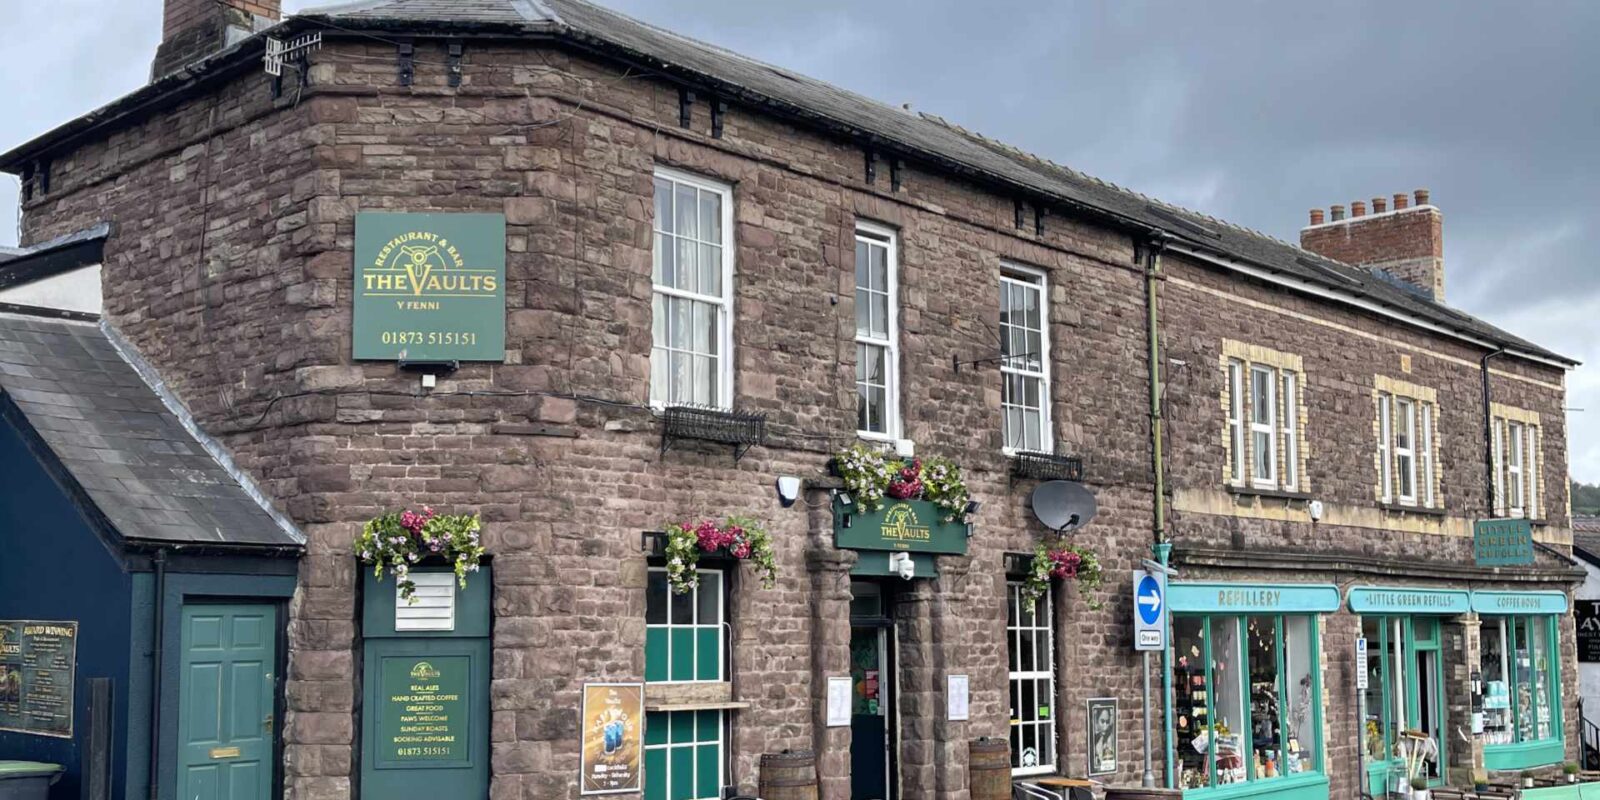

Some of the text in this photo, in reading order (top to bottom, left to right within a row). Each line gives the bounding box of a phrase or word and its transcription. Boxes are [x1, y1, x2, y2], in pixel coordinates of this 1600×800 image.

[375, 232, 463, 268] RESTAURANT & BAR
[363, 264, 497, 296] THE VAULTS
[397, 301, 440, 310] Y FENNI
[382, 332, 476, 345] 01873 515151
[881, 522, 930, 540] THE VAULTS
[1479, 536, 1527, 547] GREEN
[1218, 590, 1280, 606] REFILLERY
[1369, 593, 1451, 607] LITTLE GREEN REFILLS
[1497, 596, 1519, 608] COFFEE
[398, 747, 450, 756] 01873 515151
